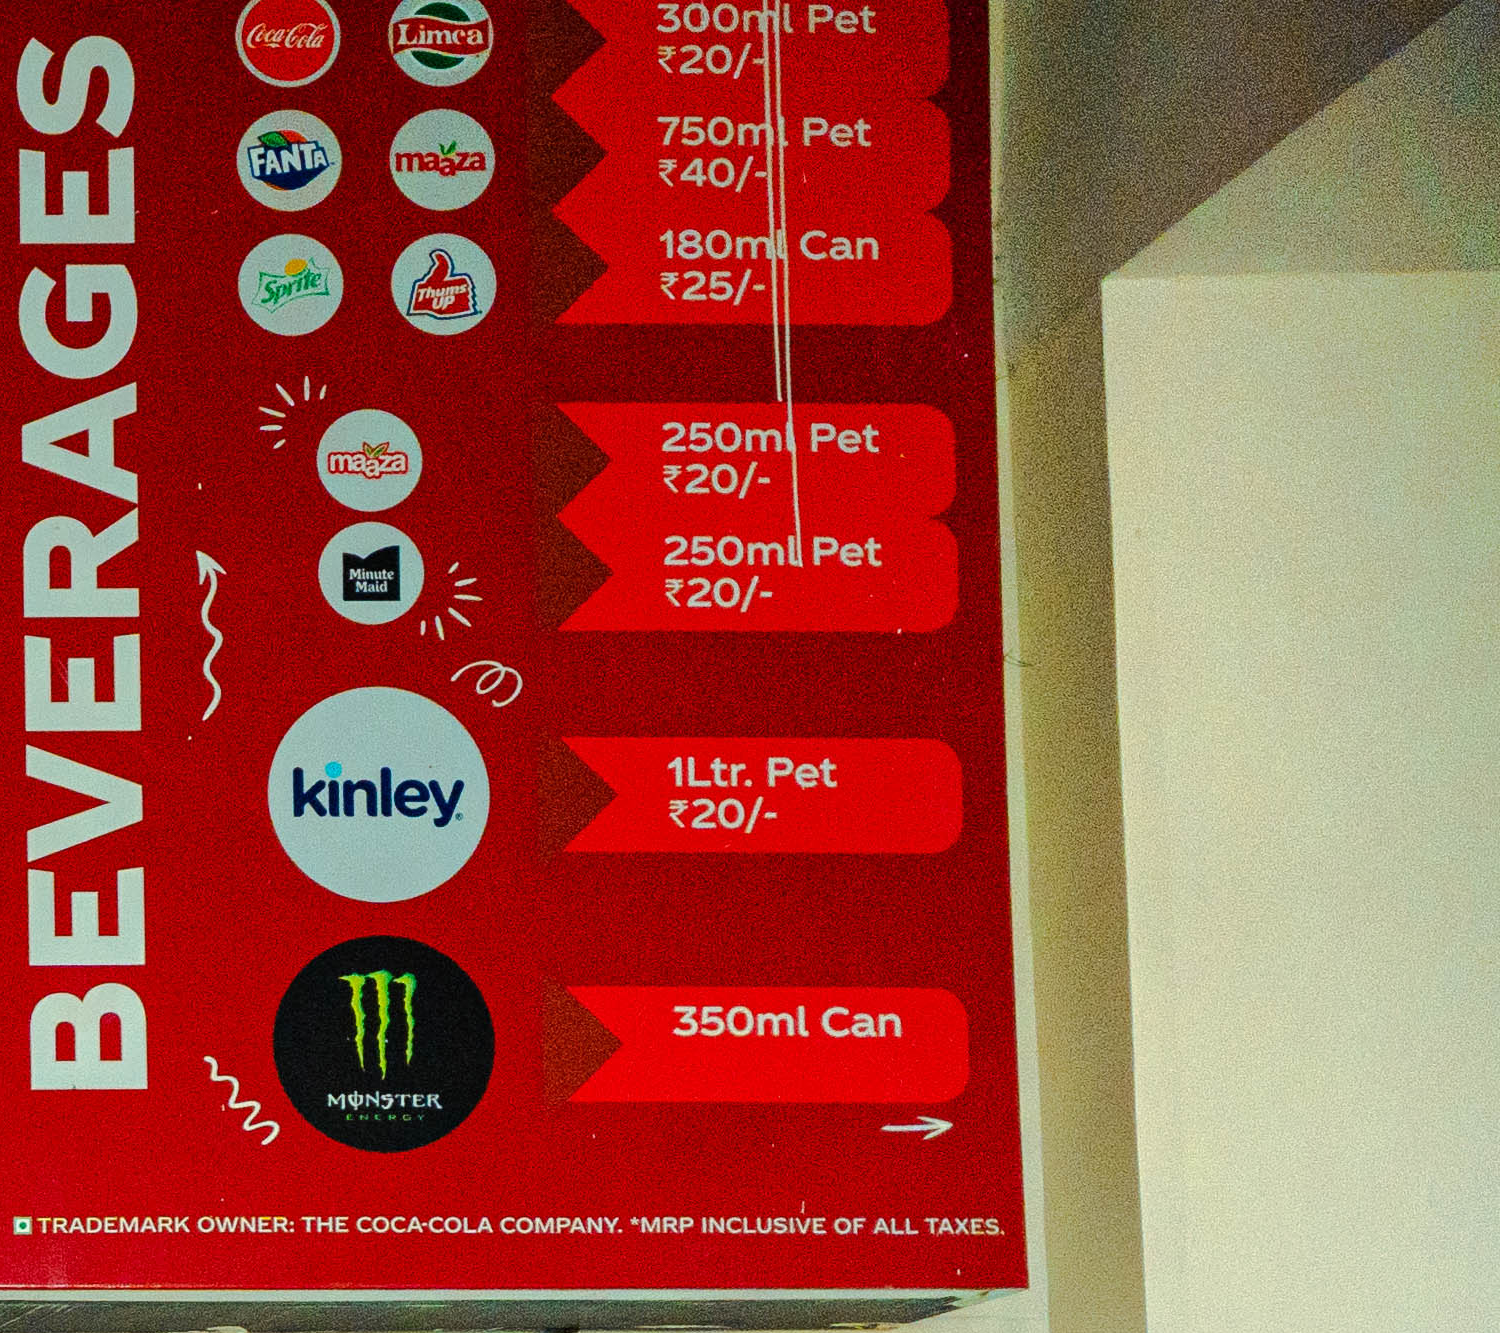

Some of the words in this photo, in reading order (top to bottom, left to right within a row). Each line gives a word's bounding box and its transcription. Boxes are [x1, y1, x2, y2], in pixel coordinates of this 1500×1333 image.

[656, 2, 794, 33] 300ml
[807, 4, 877, 33] Pet
[247, 22, 329, 48] Coca-Cola
[396, 23, 484, 46] Limca
[656, 116, 789, 147] 750ml
[802, 117, 872, 147] Pet
[250, 144, 327, 177] FANTA
[395, 151, 486, 177] maaza
[659, 229, 787, 261] 180ml
[799, 229, 880, 261] Can
[263, 269, 322, 305] Sprite
[417, 284, 468, 301] Thums
[432, 297, 456, 310] UP
[661, 422, 795, 454] 250ml
[809, 423, 880, 454] Pet
[329, 452, 407, 477] maaza
[17, 35, 148, 1091] BEVERAGES
[663, 535, 802, 568] 250ml
[811, 536, 882, 568] Pet
[349, 568, 394, 580] Minute
[355, 580, 388, 592] Maid
[666, 756, 754, 789] 1Ltr.
[767, 756, 839, 789] Pet
[292, 760, 463, 828] kinley
[671, 1004, 809, 1038] 350ml
[821, 1006, 903, 1038] Can
[345, 1112, 426, 1122] ENERGY
[37, 1216, 190, 1235] TRADEMARK
[196, 1216, 294, 1235] OWNER:
[302, 1216, 349, 1235] THE
[356, 1216, 493, 1235] COCA-COLA
[500, 1216, 623, 1235] COMPANY.
[701, 1216, 827, 1235] INCLUSIVE
[834, 1216, 864, 1235] OF
[872, 1216, 918, 1235] ALL
[924, 1216, 1005, 1235] TAXES.
